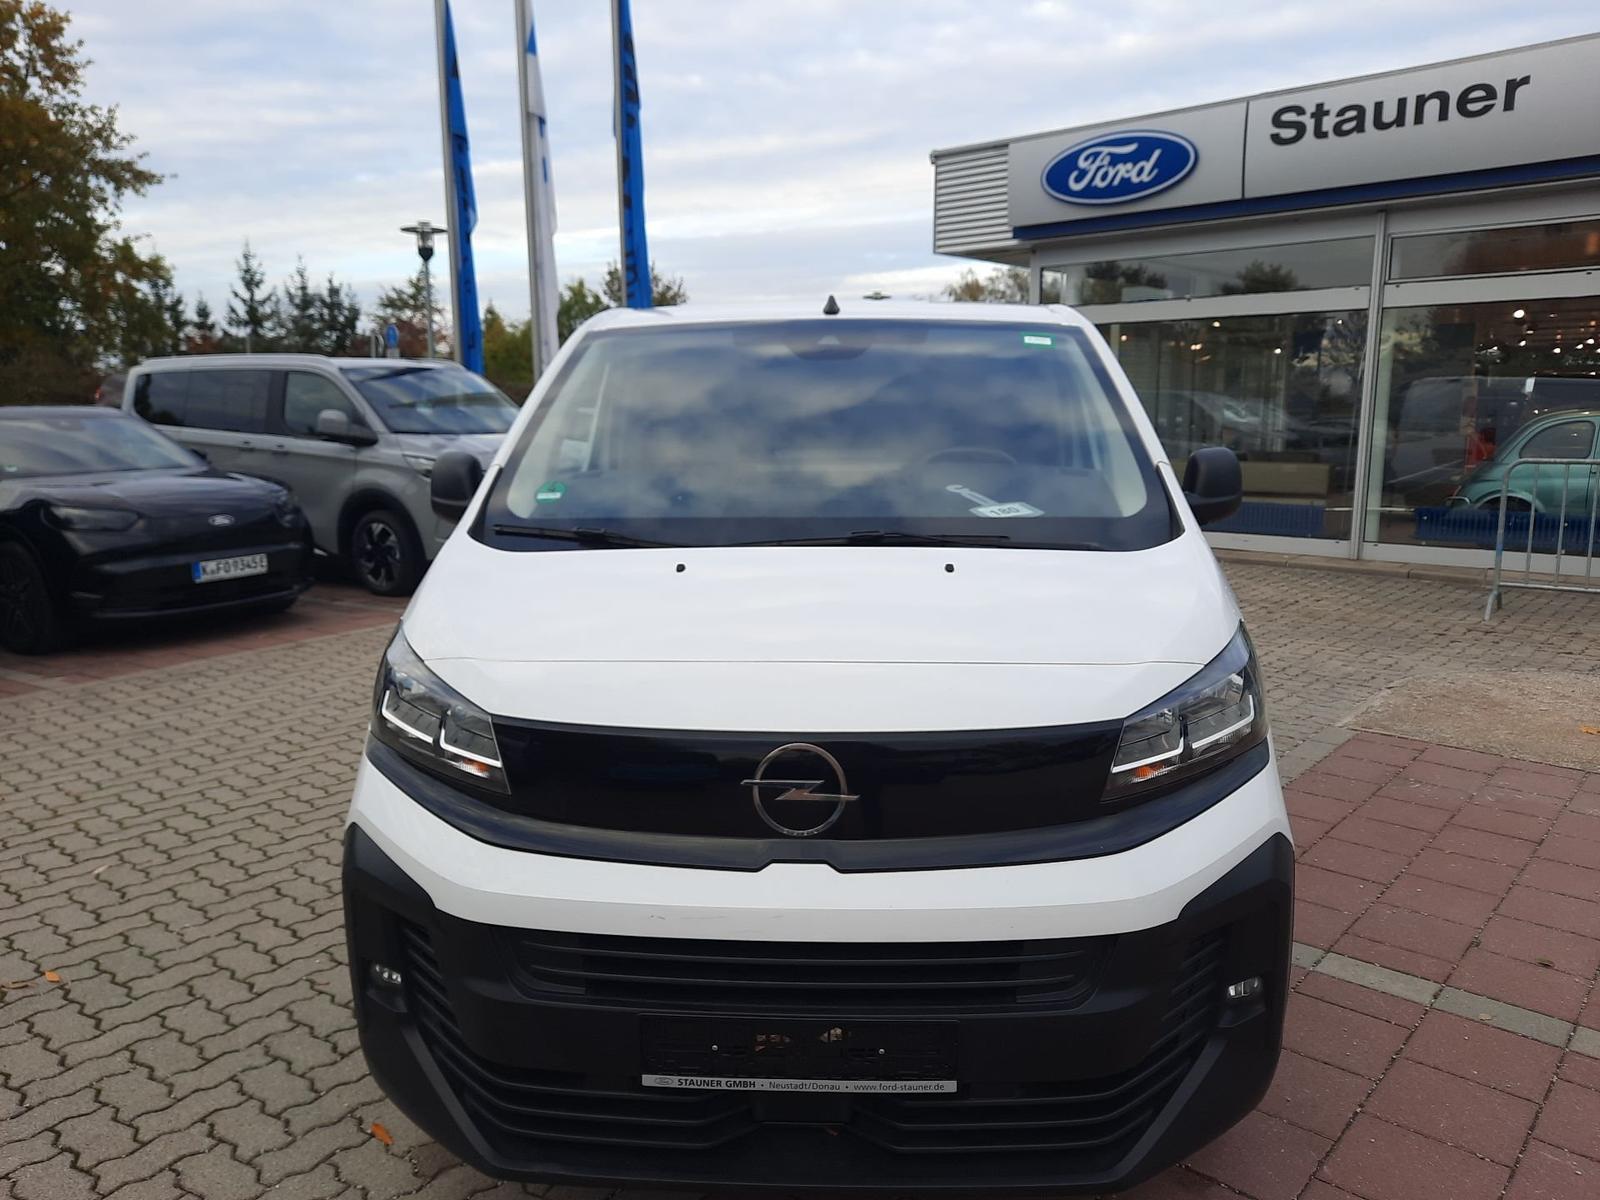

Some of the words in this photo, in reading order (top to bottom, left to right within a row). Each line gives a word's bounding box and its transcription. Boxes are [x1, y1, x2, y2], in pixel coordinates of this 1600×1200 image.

[1270, 75, 1531, 146] Stauner
[1068, 142, 1162, 191] Ford
[677, 1078, 722, 1088] STAUNER
[725, 1080, 756, 1089] GMBH
[769, 1081, 841, 1091] Neustadt/Donau
[853, 1083, 945, 1092] www.ford-stauner.de
